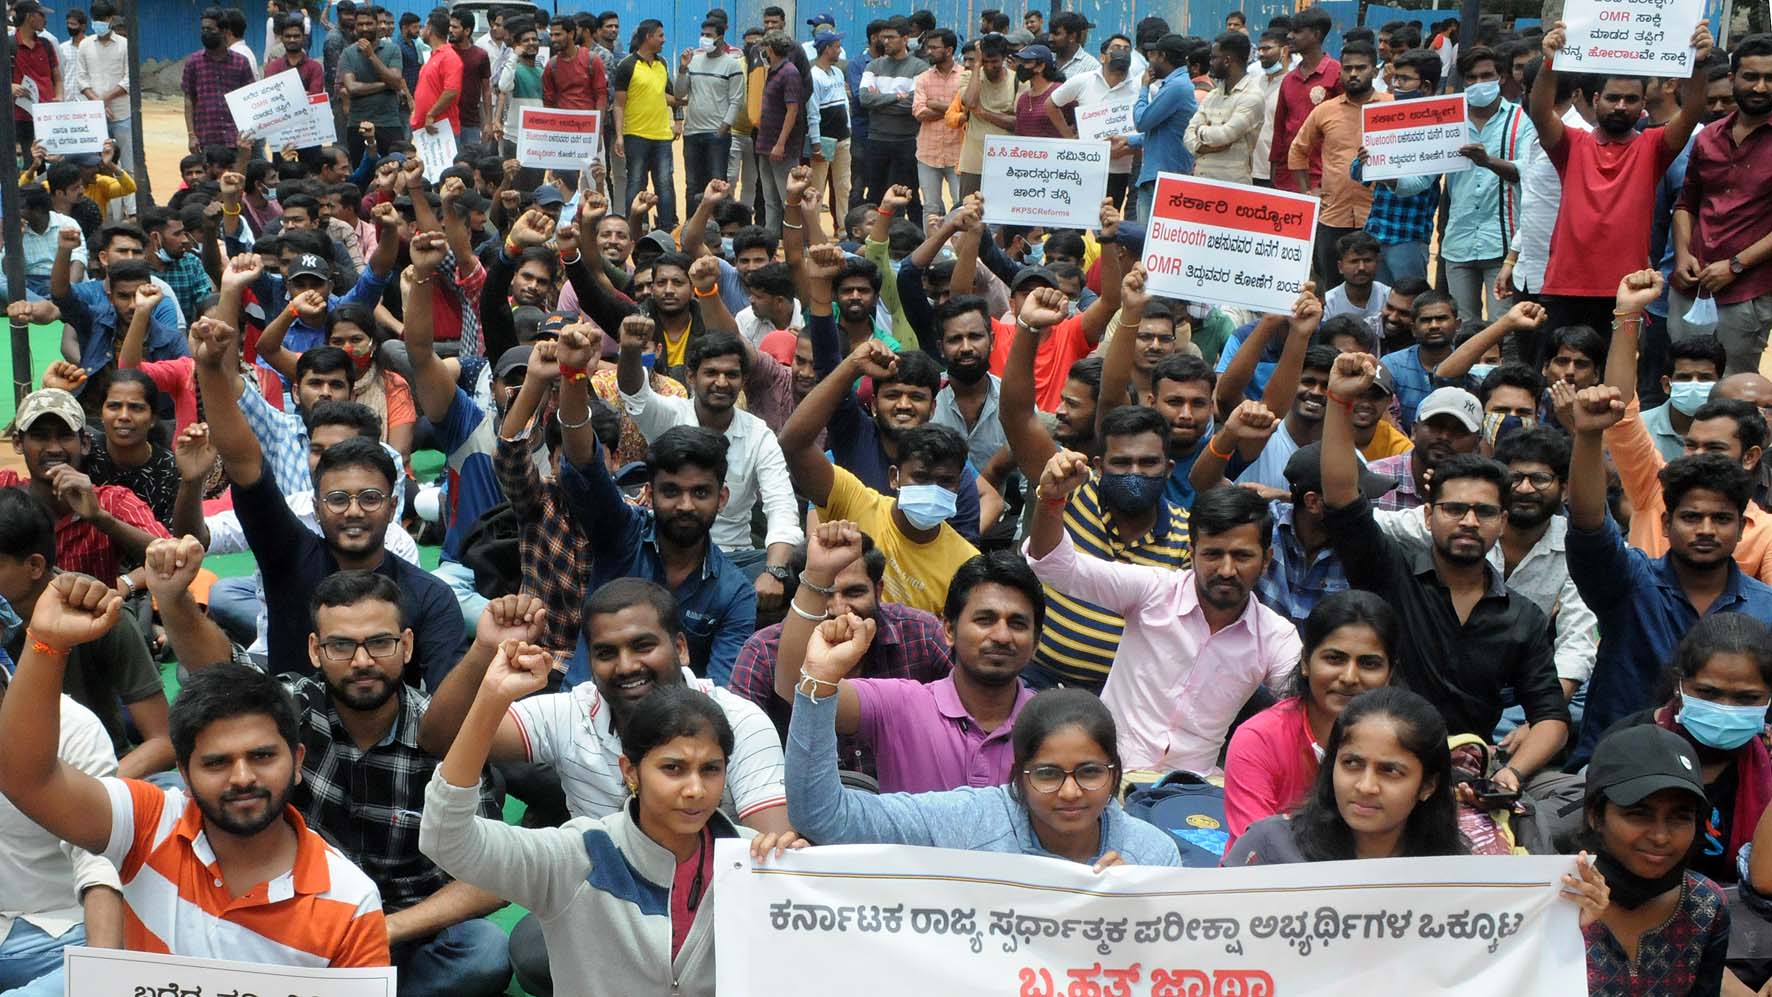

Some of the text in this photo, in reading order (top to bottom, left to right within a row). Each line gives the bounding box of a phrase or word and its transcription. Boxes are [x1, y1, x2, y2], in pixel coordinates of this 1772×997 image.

[1599, 11, 1662, 28] OMR ಸಾಕ್ಷಿ
[1590, 28, 1664, 45] ಮಾಡದ ತಪ್ಪಿಗೆ
[1588, 46, 1655, 60] ಹೋರಾಟವೇ
[1660, 51, 1687, 66] ಸಾಕ್ಷಿ
[1056, 150, 1100, 162] ಸಮಿತಿಯ
[1366, 154, 1386, 167] OMR
[1006, 166, 1082, 185] ಶಿಫಾರಸ್ಸುಗಳನ್ನು
[1013, 187, 1071, 204] ಜಾರಿಗೆ ತನ್ನಿ
[1011, 207, 1070, 217] #KPSCReforms
[1168, 192, 1303, 232] ಸರ್ಕಾರಿ ಉದ್ಯೋಗ
[1151, 222, 1302, 262] Bluetooth ಬಳಸುವವರ ಮನೆಗೆ ಬಂತು
[1146, 254, 1303, 294] OMR ತಿದ್ದುವವರ ಕೋಣೆಗೆ ಬಂತು
[769, 899, 1524, 956] ಕರ್ನಾಟಕ ರಾಜ್ಯ ಸ್ಪರ್ಧಾತ್ಮಕ ಪರೀಕ್ಷಾ ಅಭ್ಯರ್ಥಿಗಳ ಒಕ್ಕೂಟ
